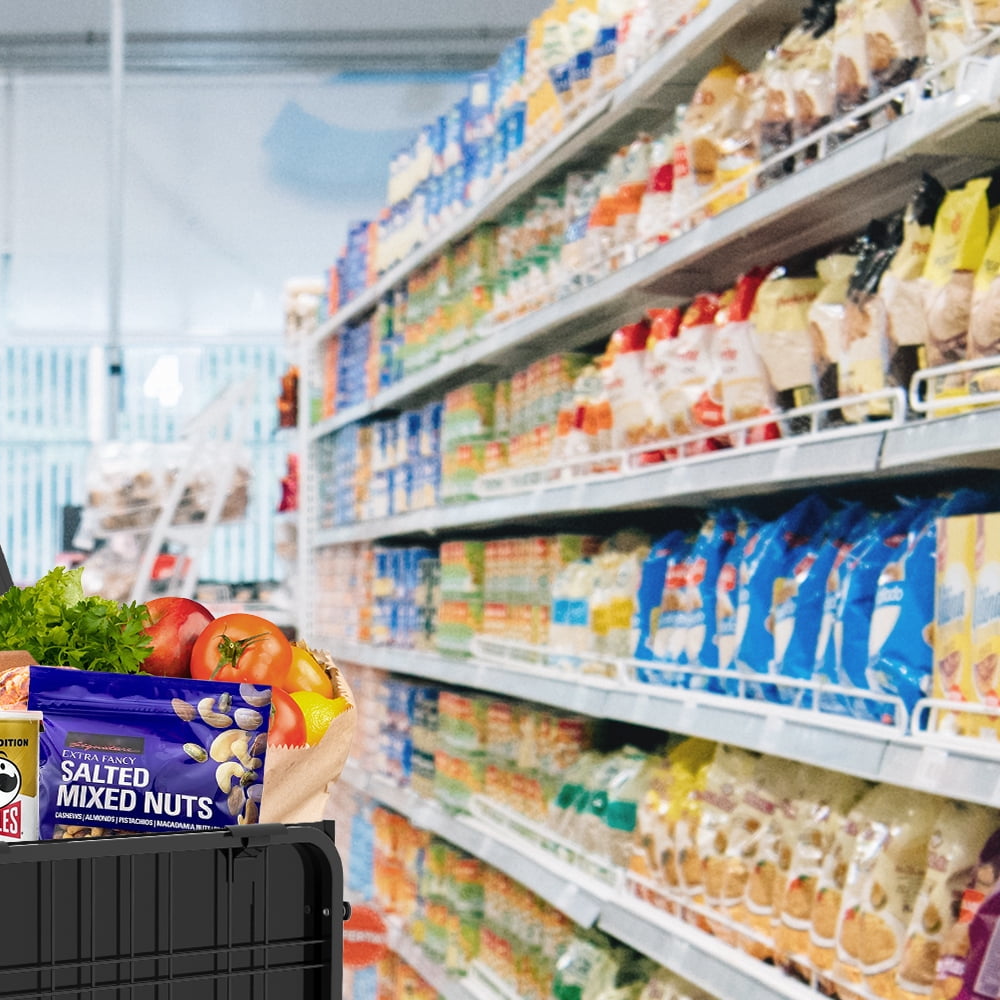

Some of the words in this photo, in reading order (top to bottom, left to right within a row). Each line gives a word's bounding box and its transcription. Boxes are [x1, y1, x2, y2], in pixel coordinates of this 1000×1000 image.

[143, 355, 184, 408] 4
[62, 749, 99, 762] EXTRA
[102, 755, 137, 765] FANCY
[61, 760, 150, 788] SALTED
[56, 784, 137, 812] MIXED
[144, 791, 213, 820] NUTS
[55, 812, 82, 820] CASHEWS
[85, 814, 115, 823] ALMONDS
